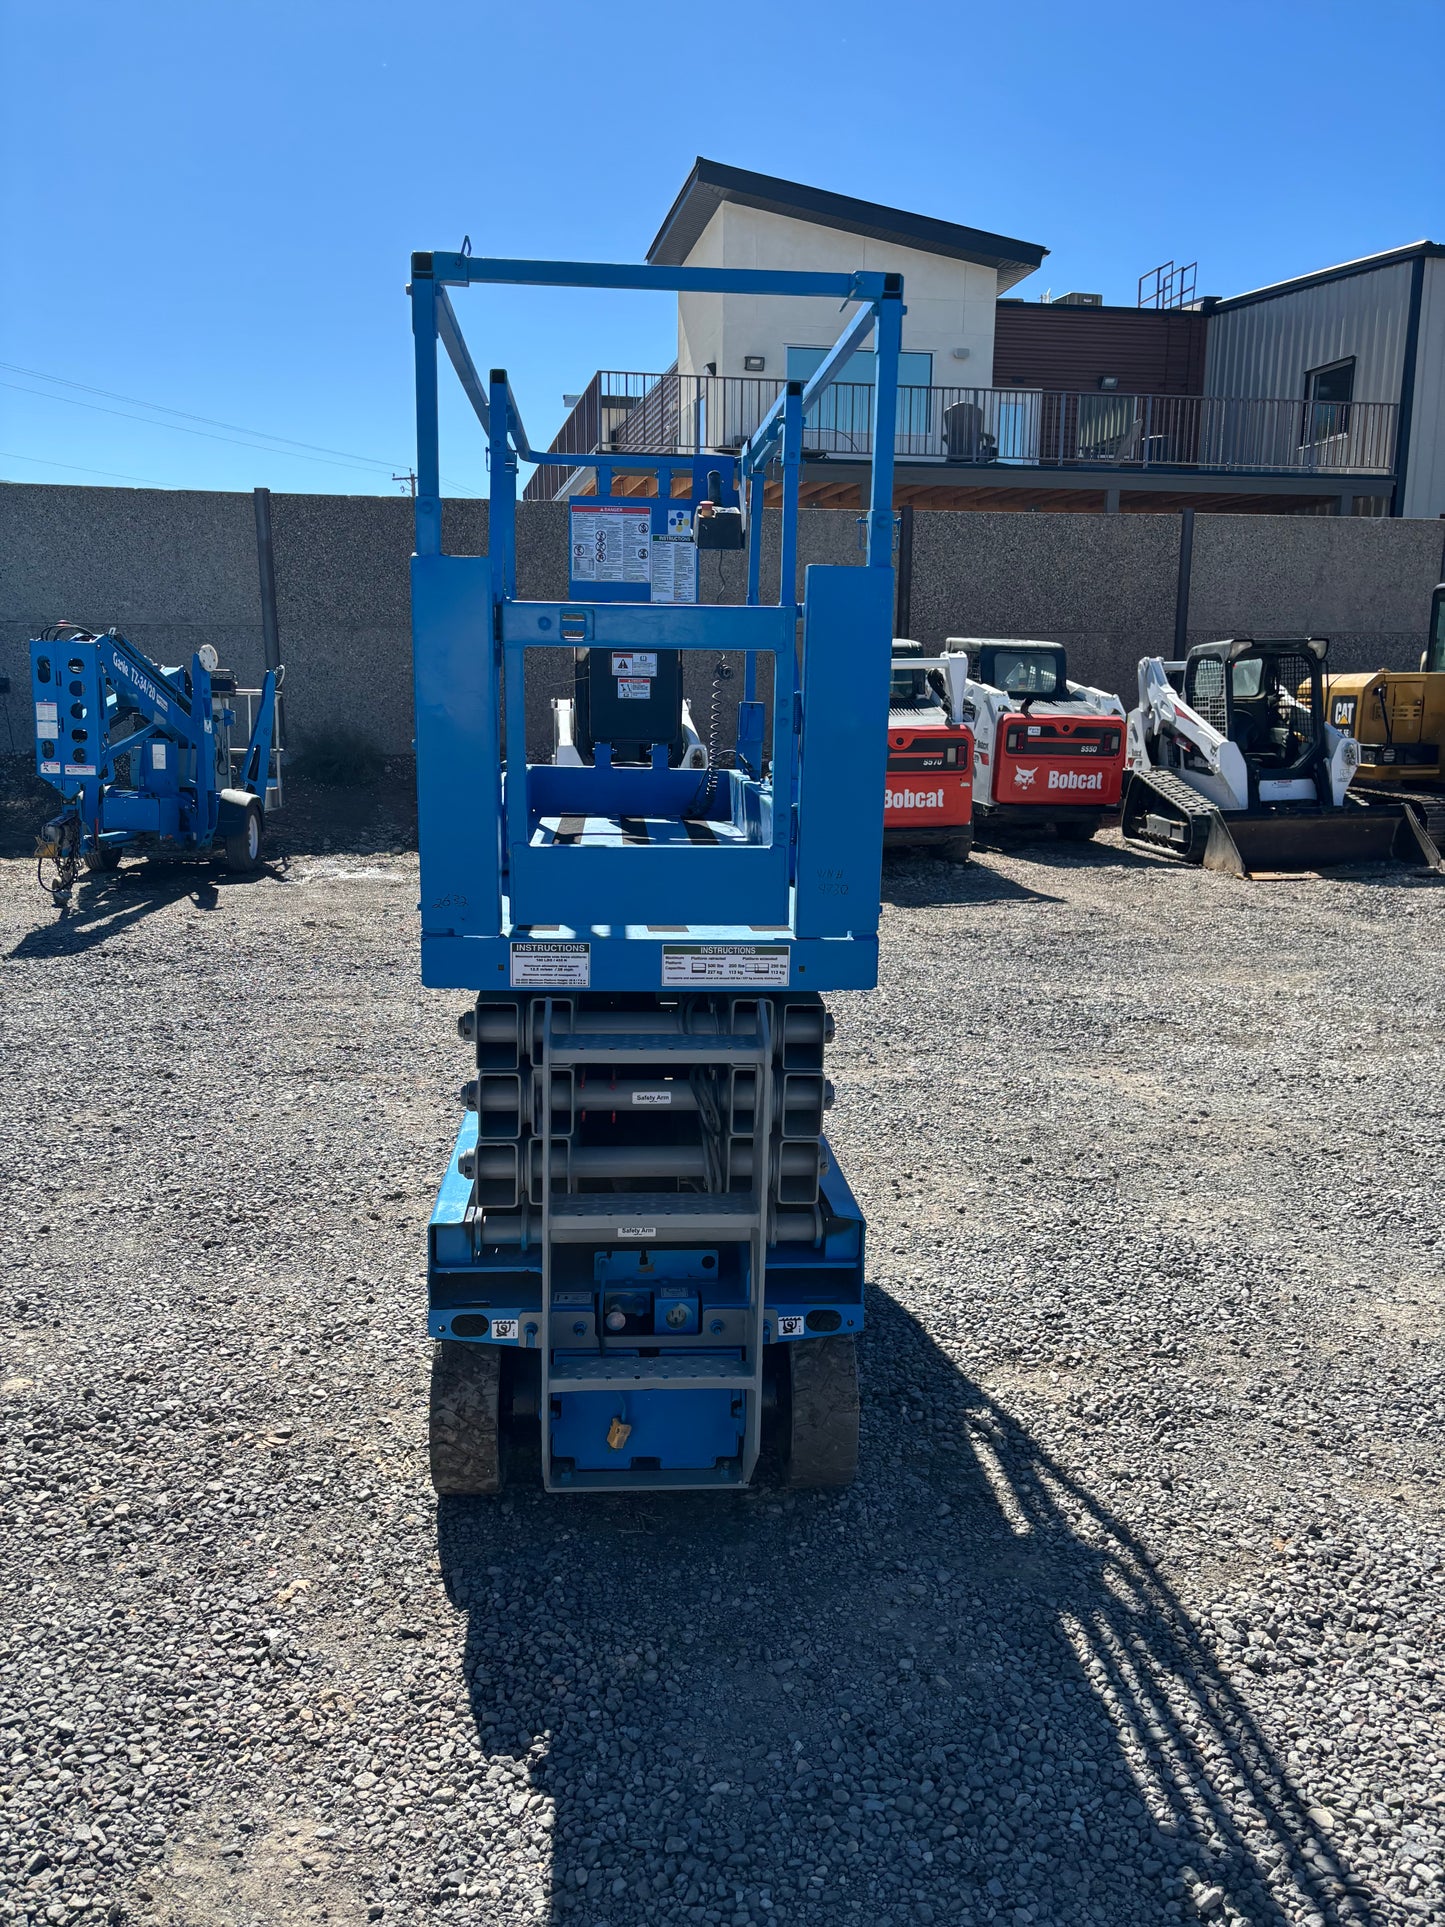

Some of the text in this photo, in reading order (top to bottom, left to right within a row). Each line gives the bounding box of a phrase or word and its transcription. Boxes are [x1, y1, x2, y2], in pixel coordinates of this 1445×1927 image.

[1334, 702, 1354, 724] CAT
[1080, 745, 1098, 753] S550
[1048, 770, 1103, 790] Bobcat
[884, 788, 944, 809] Bobcat
[516, 944, 585, 952] INSTRUCTIONS
[700, 946, 756, 954] INSTRUCTIONS
